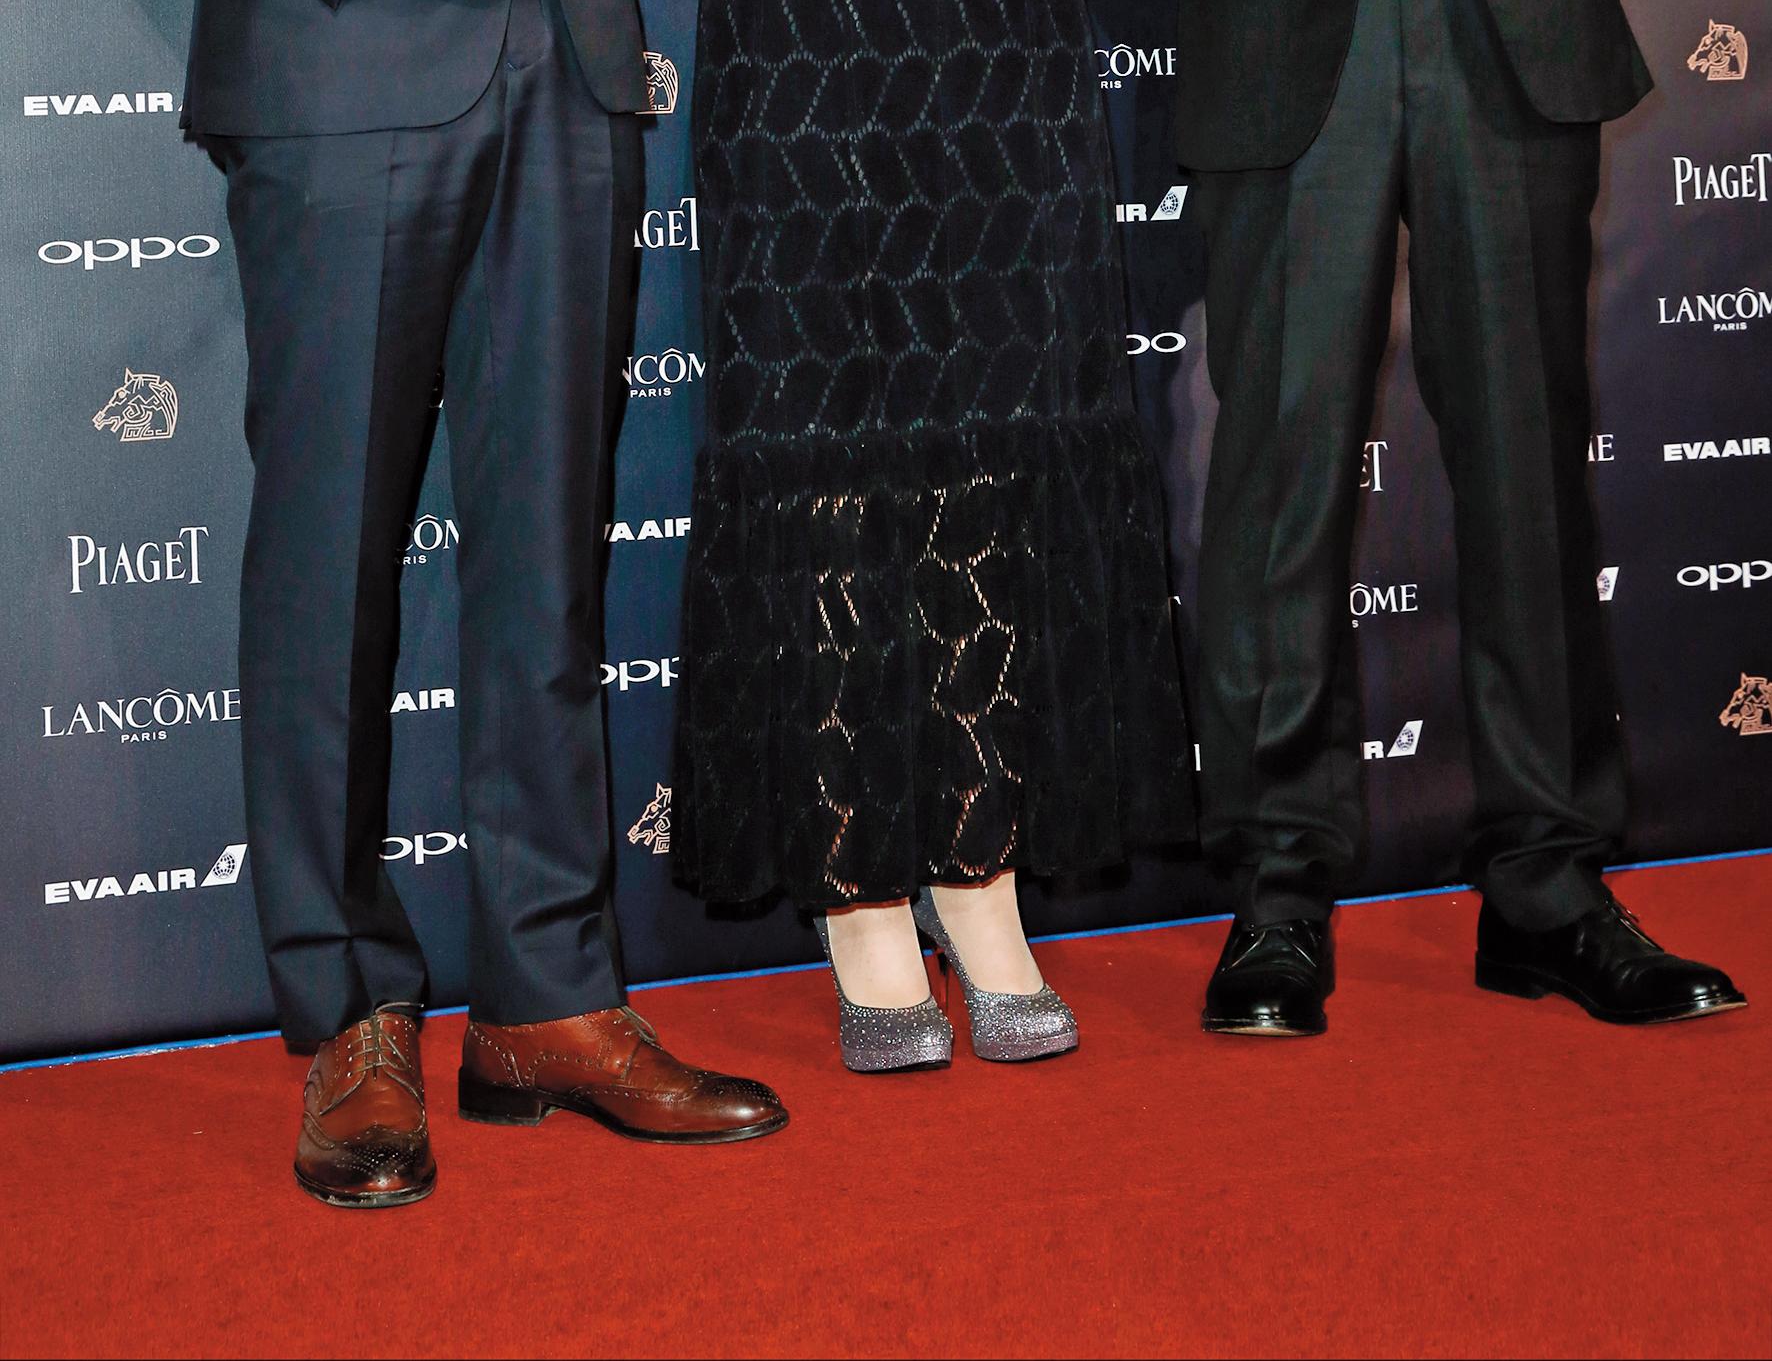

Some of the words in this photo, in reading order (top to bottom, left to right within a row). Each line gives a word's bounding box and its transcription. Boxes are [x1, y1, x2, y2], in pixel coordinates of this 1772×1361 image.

[1094, 44, 1176, 76] CÔME
[1101, 81, 1122, 89] RIS
[1672, 153, 1772, 206] PIAGET
[634, 198, 700, 251] GET
[1658, 287, 1772, 323] LANCÔM
[1714, 322, 1747, 331] PARIS
[630, 388, 671, 397] PARIS
[67, 526, 209, 594] PIAGET
[403, 555, 427, 564] RIS
[1677, 561, 1772, 591] opp
[42, 688, 241, 737] LANCÔME
[121, 731, 167, 743] PARIS
